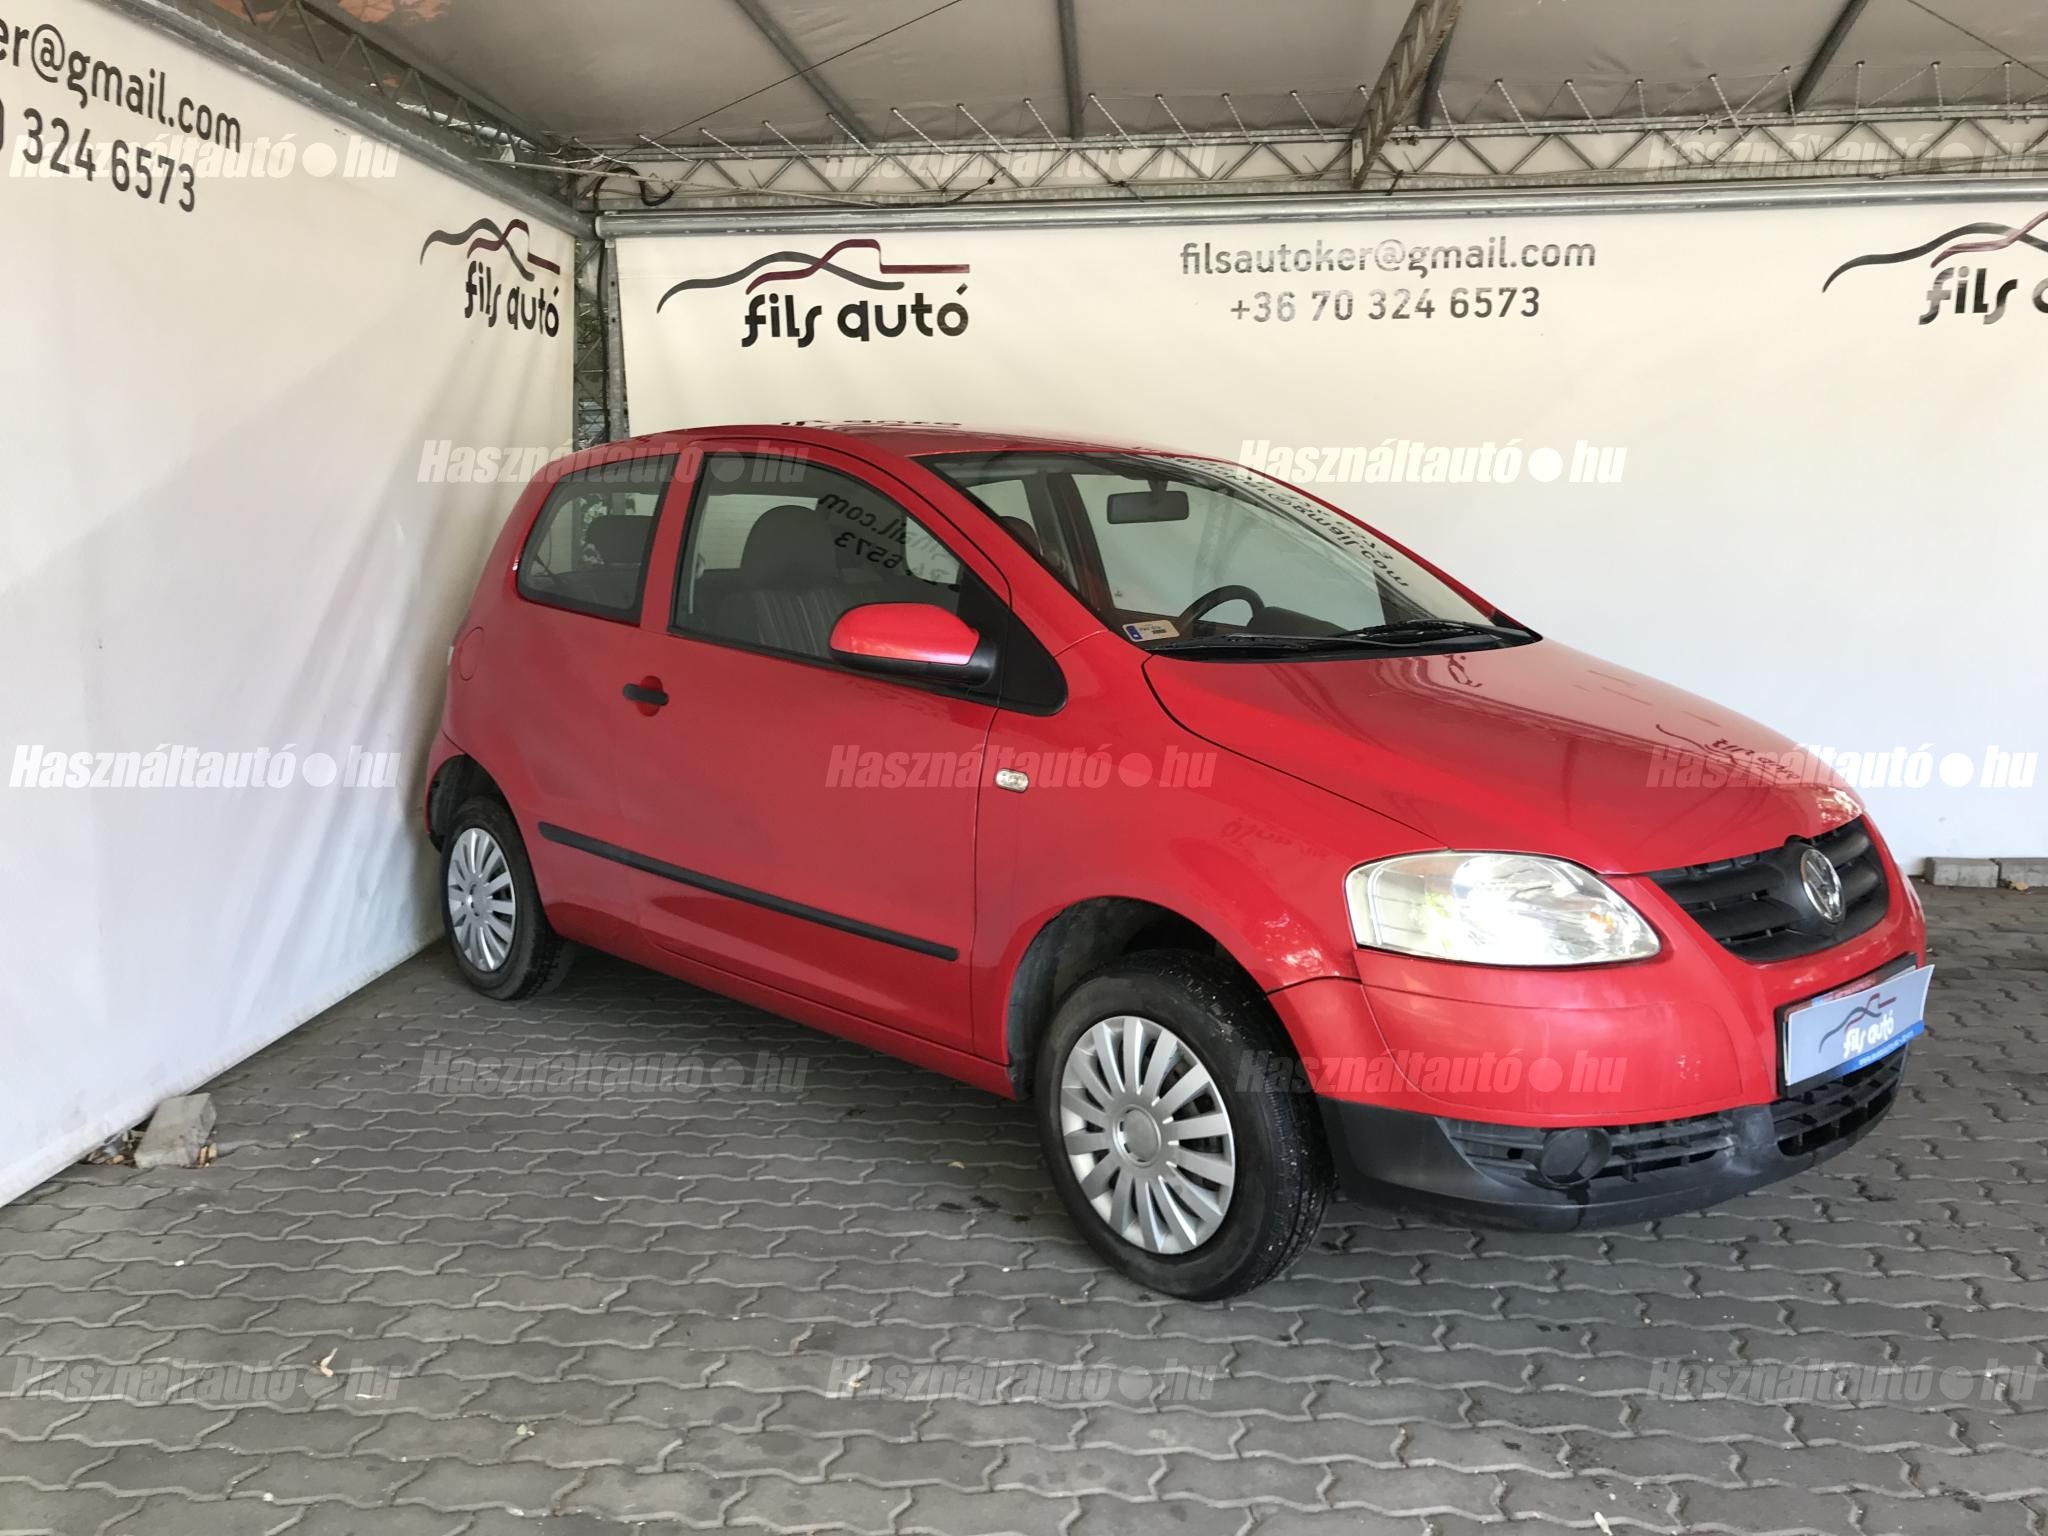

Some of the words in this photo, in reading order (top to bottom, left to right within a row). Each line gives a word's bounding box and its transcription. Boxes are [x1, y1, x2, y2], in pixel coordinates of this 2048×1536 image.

[23, 108, 96, 181] 324
[112, 139, 195, 212] 6573
[1180, 236, 1596, 279] filsautoker@gmail.com
[464, 260, 502, 328] fils
[507, 286, 559, 338] autó
[741, 294, 823, 347] fils
[837, 283, 970, 341] autó
[1230, 291, 1297, 323] +36
[1311, 289, 1354, 321] 70
[1368, 288, 1436, 320] 324
[1449, 286, 1540, 319] 6573
[1918, 266, 2018, 325] fils
